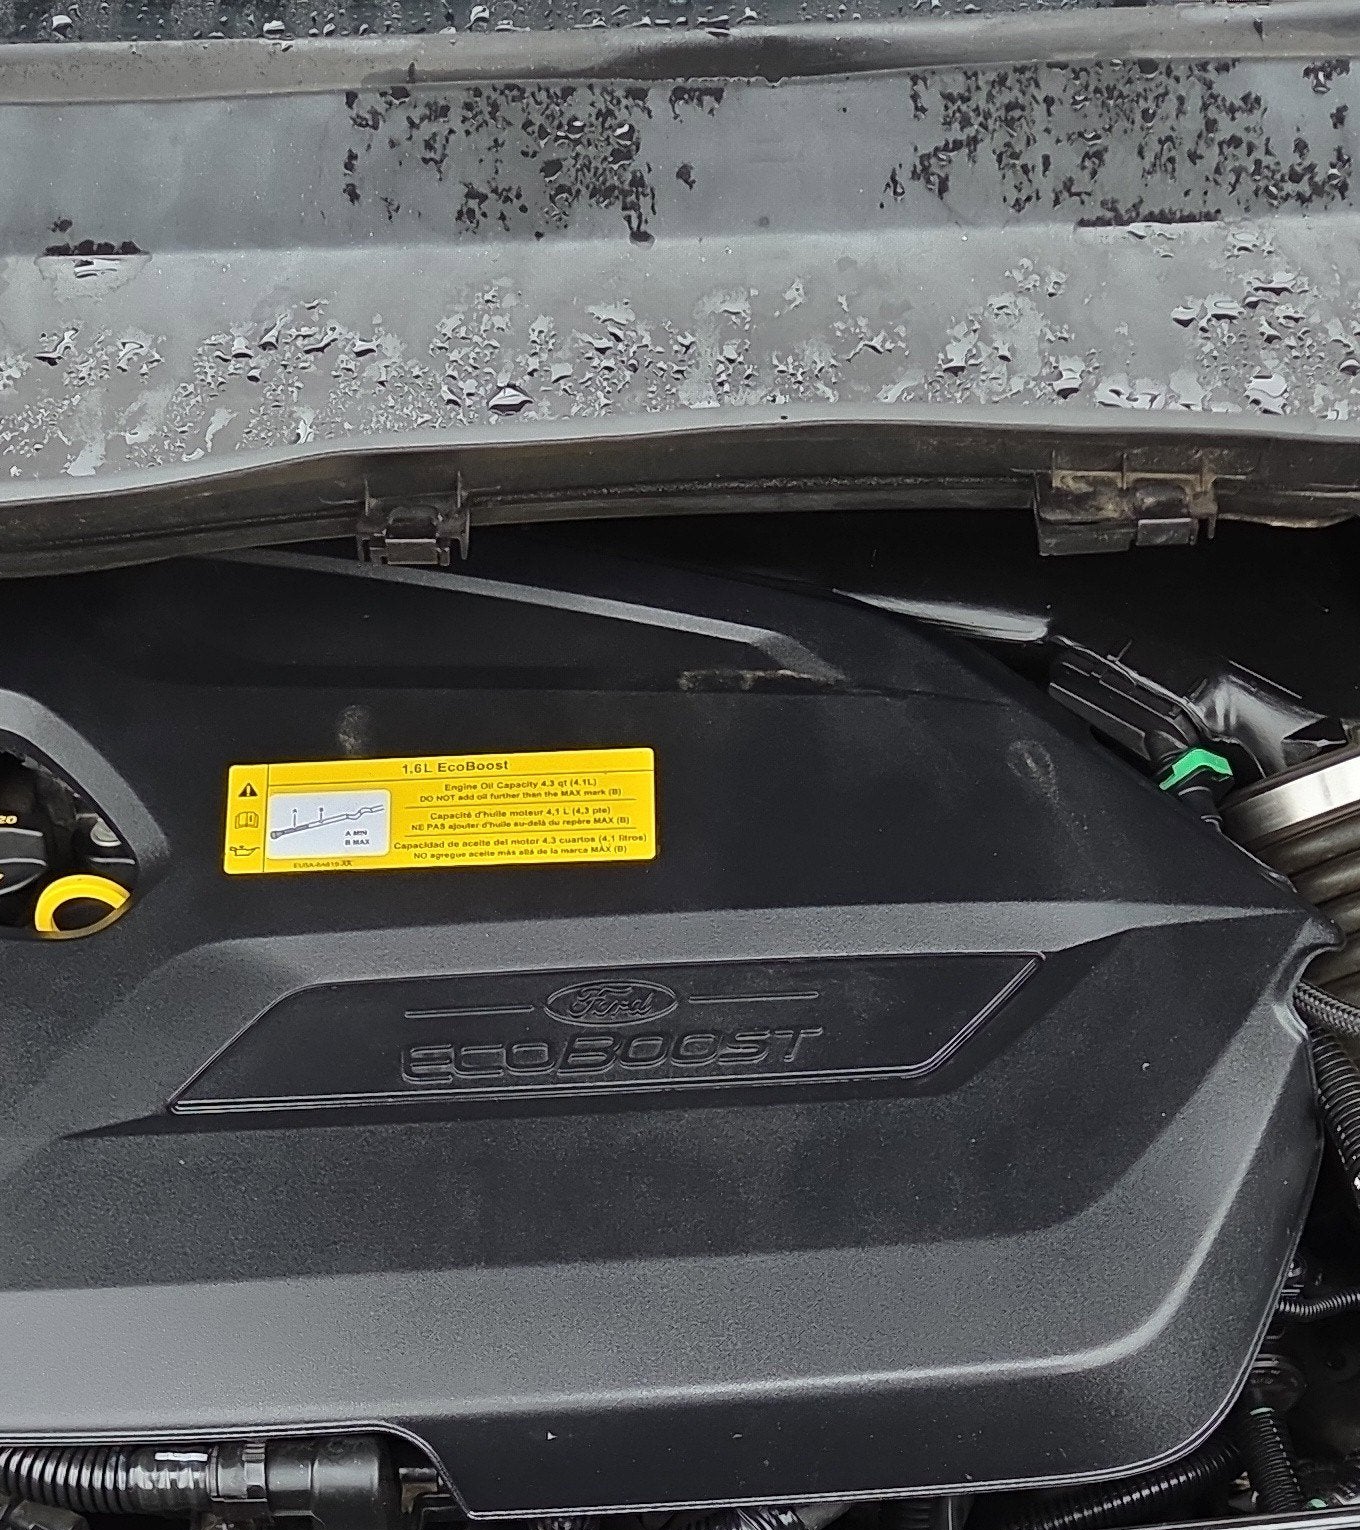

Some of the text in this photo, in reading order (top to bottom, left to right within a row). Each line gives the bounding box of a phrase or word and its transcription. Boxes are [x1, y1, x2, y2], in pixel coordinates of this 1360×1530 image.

[438, 760, 509, 773] EcoBoost
[445, 783, 477, 792] Engine
[481, 782, 493, 790] Oil
[497, 781, 538, 790] Capacity
[490, 791, 520, 799] further
[430, 812, 472, 821] Capacité
[448, 823, 478, 831] ajouter
[563, 818, 591, 826] repère
[394, 841, 444, 850] Capacidad
[430, 852, 466, 860] agregue
[568, 984, 653, 1020] Ford
